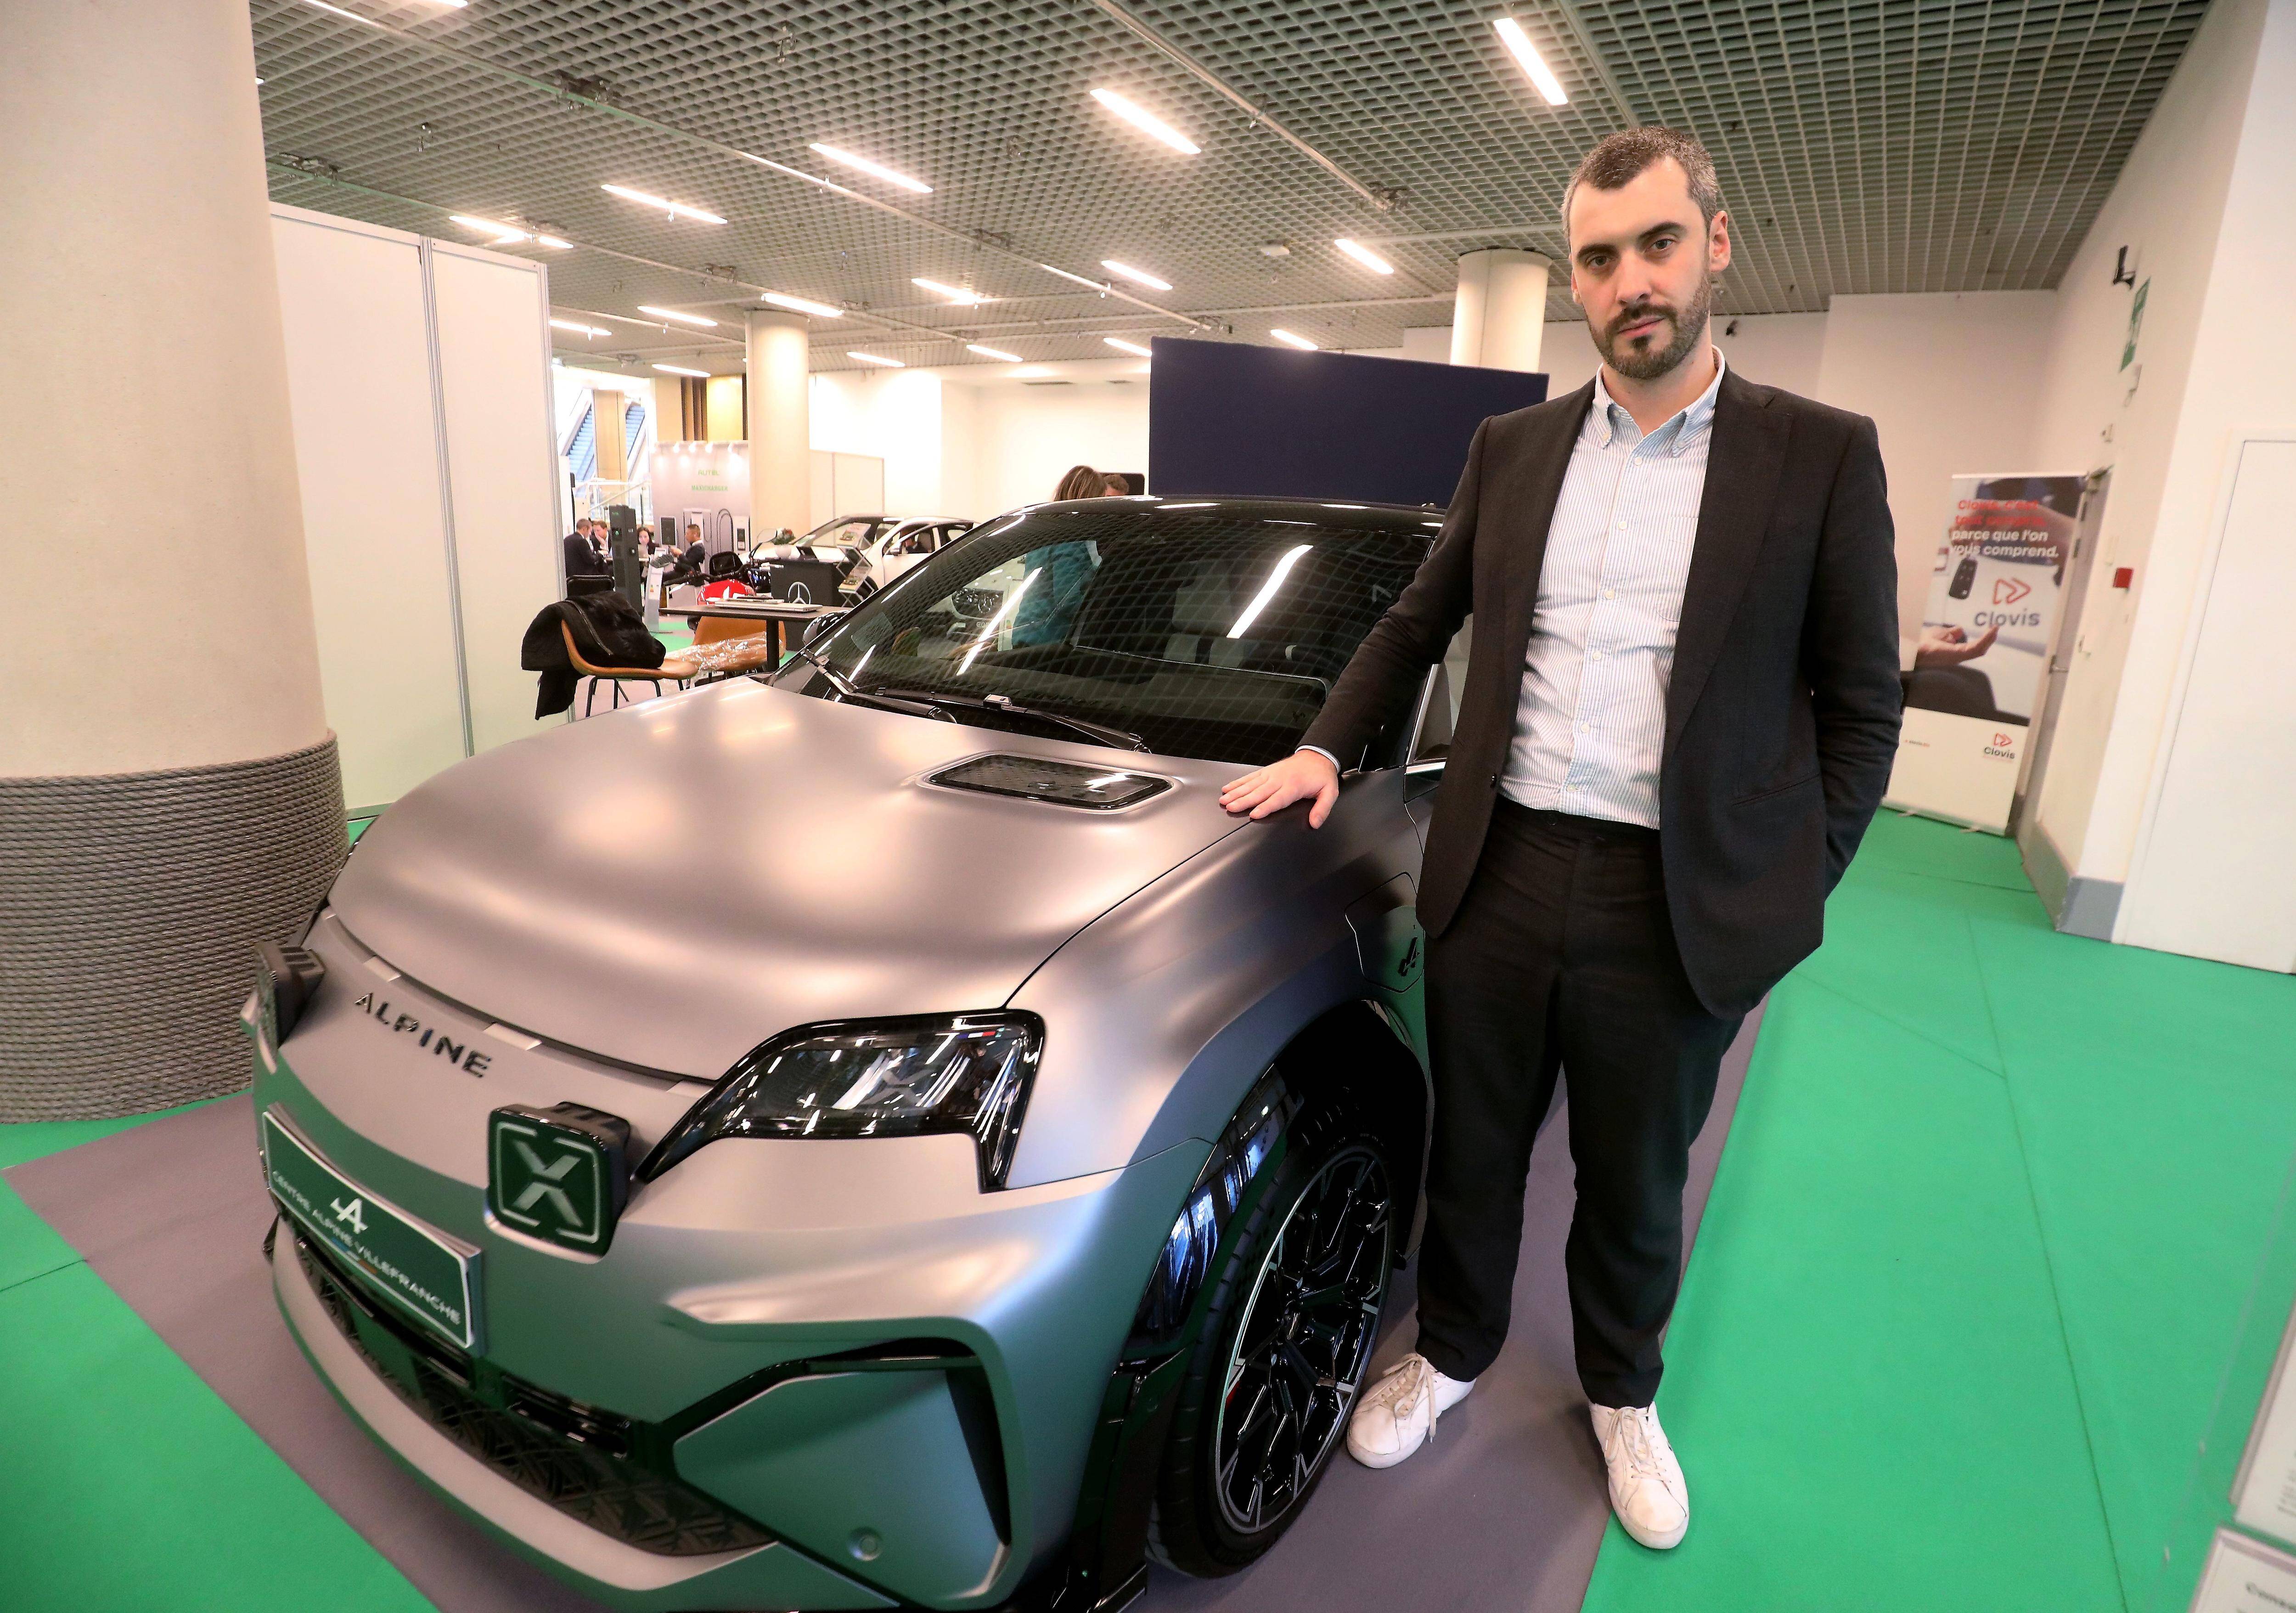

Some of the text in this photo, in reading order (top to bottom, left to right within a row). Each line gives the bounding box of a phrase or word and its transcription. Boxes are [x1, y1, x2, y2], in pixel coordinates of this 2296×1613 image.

[1952, 529, 2049, 542] parce que l'on
[1950, 543, 2060, 558] vous comprend.
[1974, 608, 2040, 627] Clovis
[1983, 746, 2015, 759] Clovis
[354, 992, 493, 1078] ALPINE
